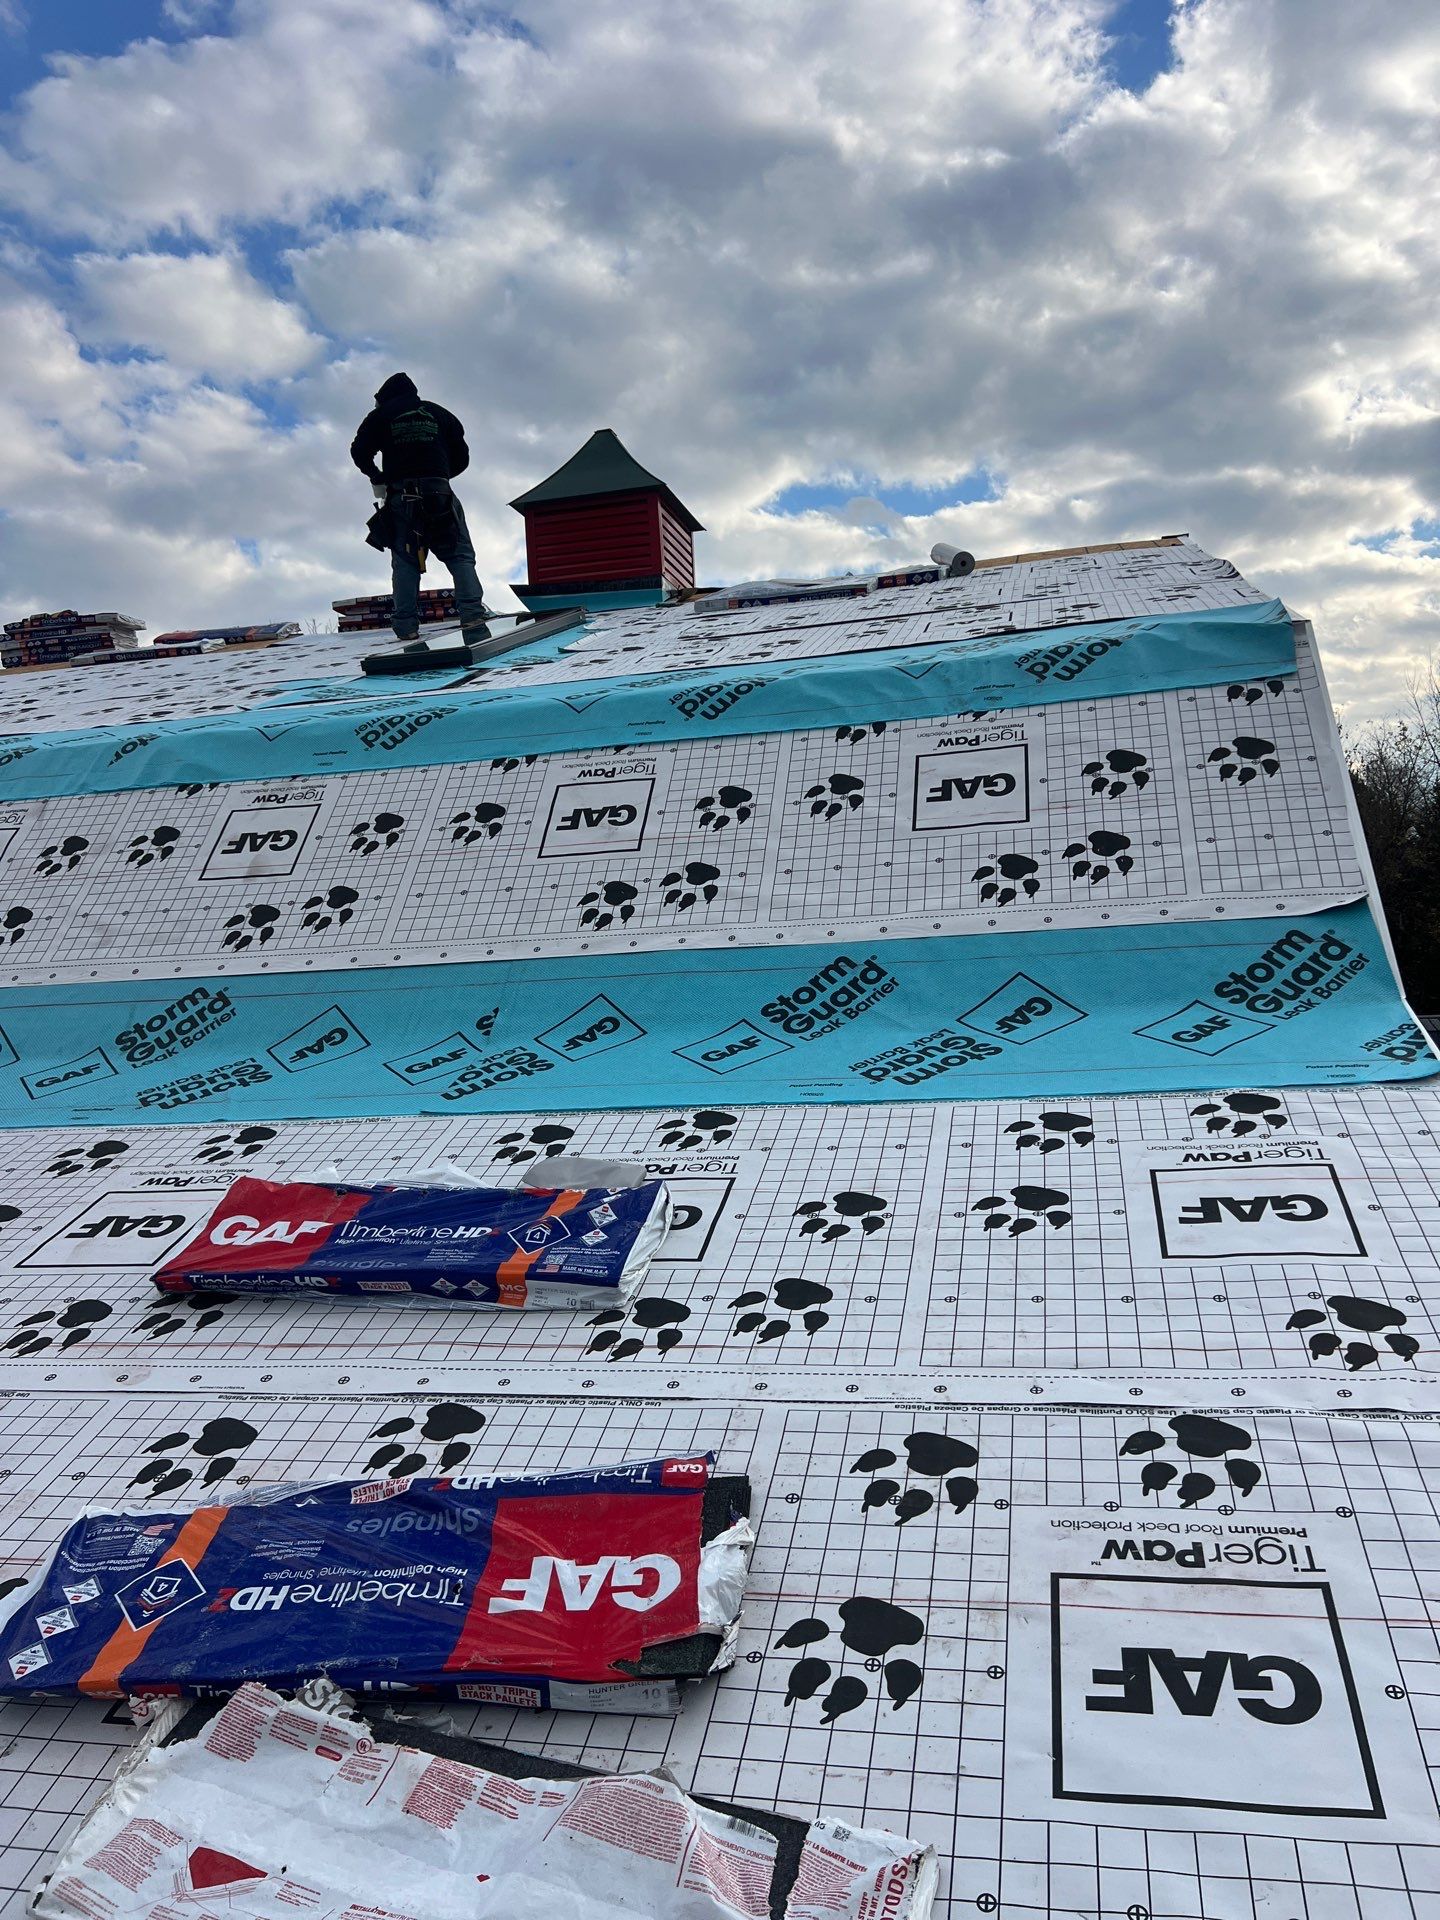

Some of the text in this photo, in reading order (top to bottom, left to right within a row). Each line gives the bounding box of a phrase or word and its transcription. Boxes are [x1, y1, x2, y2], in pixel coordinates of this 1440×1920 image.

[926, 773, 1016, 802] GAF
[556, 804, 638, 831] GAF
[220, 830, 298, 854] GAF
[1214, 928, 1316, 1005] Storm
[1244, 930, 1354, 1015] Guard
[761, 956, 858, 1023] Storm
[782, 957, 888, 1034] Guard
[1272, 952, 1372, 1021] Leak Barrier
[114, 986, 210, 1053] Storm
[799, 977, 900, 1042] Leak Barrier
[995, 996, 1053, 1034] GAF
[125, 988, 232, 1063] Guard
[132, 1006, 238, 1070] Leak Barrier
[563, 1016, 621, 1052] GAF
[1171, 1015, 1231, 1044] GAF
[288, 1027, 350, 1064] GAF
[701, 1036, 762, 1062] GAF
[848, 1028, 956, 1073] Leak Barrier
[404, 1048, 468, 1074] GAF
[448, 1052, 538, 1088] Gua
[860, 1036, 976, 1084] Guard
[892, 1042, 1004, 1086] Storm
[35, 1064, 102, 1088] GAF
[440, 1060, 555, 1100] Storm
[158, 1069, 274, 1110] Storm
[1146, 1144, 1203, 1152] Protection
[1238, 1142, 1264, 1150] Roof
[1266, 1140, 1319, 1148] Premium
[132, 1172, 238, 1188] igerPaw
[644, 1160, 738, 1175] TigerPa
[1178, 1194, 1329, 1224] GAF
[64, 1214, 186, 1239] GAF
[210, 1215, 334, 1246] GAF
[534, 1232, 541, 1240] 4
[1079, 1408, 1122, 1416] Puntillas
[666, 1464, 704, 1474] GAF
[353, 1478, 410, 1498] STACK PALLETS
[383, 1487, 395, 1498] NOT
[397, 1484, 408, 1492] DO
[345, 1508, 482, 1538] Shingles
[1050, 1520, 1308, 1538] Premium Roof Deck Protection
[262, 1568, 315, 1581] Shingles
[437, 1566, 468, 1577] High
[488, 1554, 682, 1614] GAF
[158, 1582, 169, 1593] 4
[461, 1690, 538, 1707] STACK PALLETS
[502, 1687, 537, 1698] TRIPLE
[588, 1684, 626, 1695] HUNTER
[642, 1688, 662, 1700] 10
[1085, 1647, 1322, 1726] GAF
[628, 1778, 665, 1794] INFORMATION
[812, 1842, 847, 1864] LA GARANTIE
[872, 1894, 880, 1910] MT.
